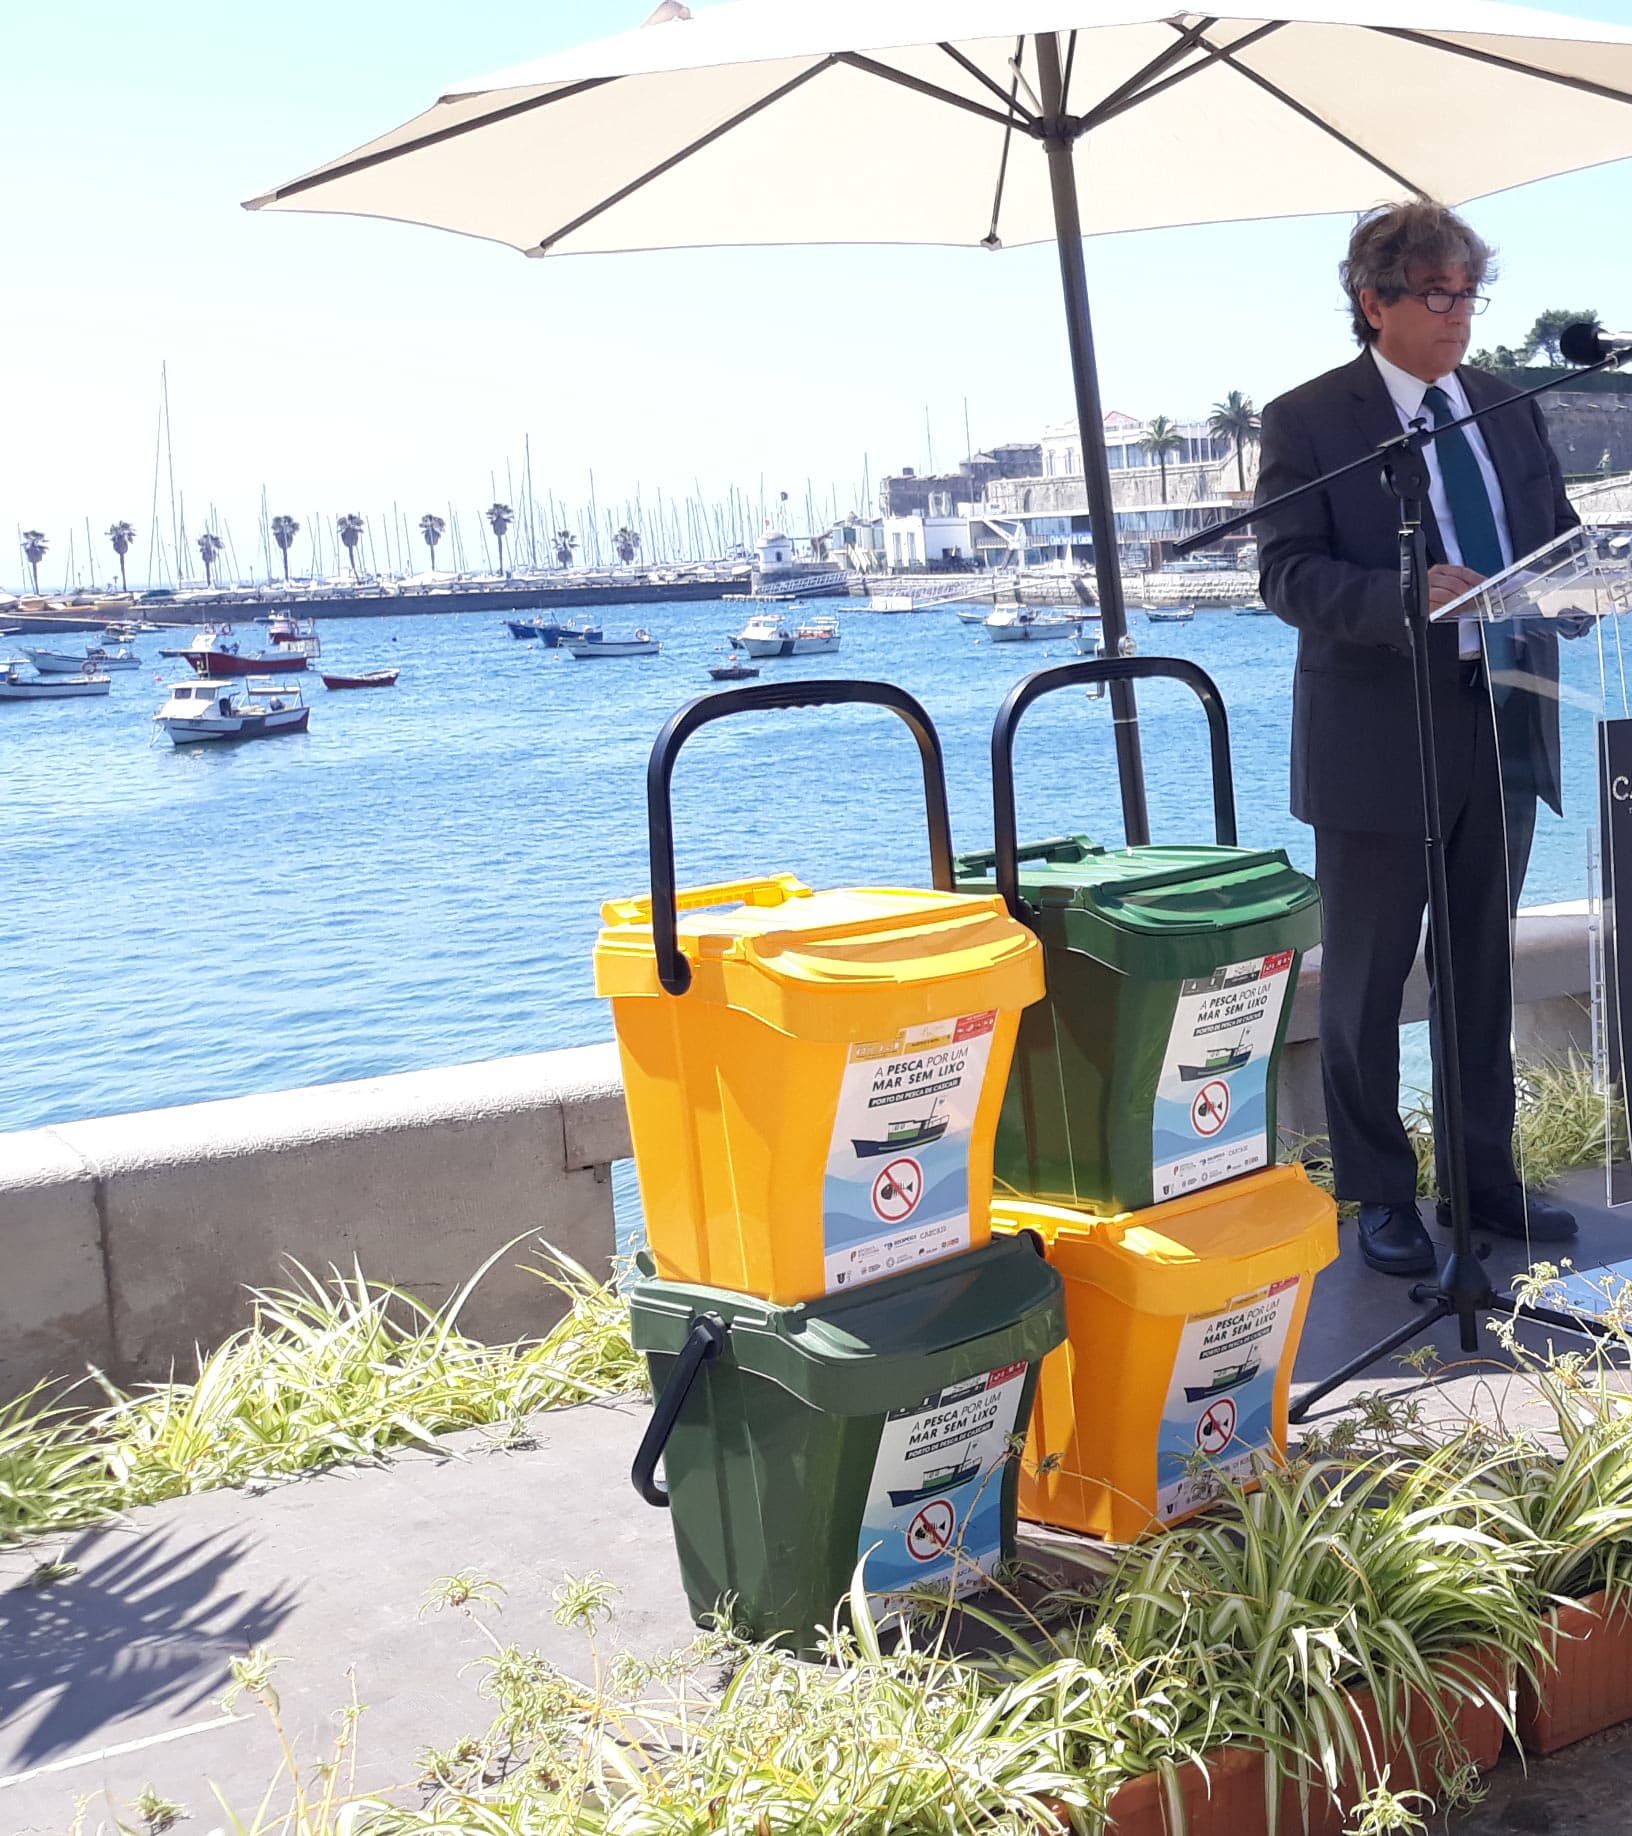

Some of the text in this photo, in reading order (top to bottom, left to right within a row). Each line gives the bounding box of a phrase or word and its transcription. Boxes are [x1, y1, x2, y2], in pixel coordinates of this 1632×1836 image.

[1197, 996, 1268, 1023] MAR SEM LIXO
[1200, 983, 1271, 1010] A PESCA POR UM
[872, 1061, 965, 1092] MAR SEM LIXO
[874, 1047, 968, 1078] A PESCA POR UM
[872, 1097, 894, 1106] PORTO
[905, 1090, 924, 1098] PESCA
[1203, 1311, 1276, 1346] MAR SEM LIXO
[1206, 1324, 1213, 1334] A
[1216, 1313, 1244, 1331] PESCA
[1247, 1306, 1264, 1320] POR
[1266, 1299, 1280, 1312] UM
[909, 1406, 998, 1445] MAR SEM LIXO
[912, 1422, 920, 1432] A
[923, 1410, 958, 1428] PESCA
[961, 1402, 981, 1415] POR
[984, 1392, 1002, 1407] UM
